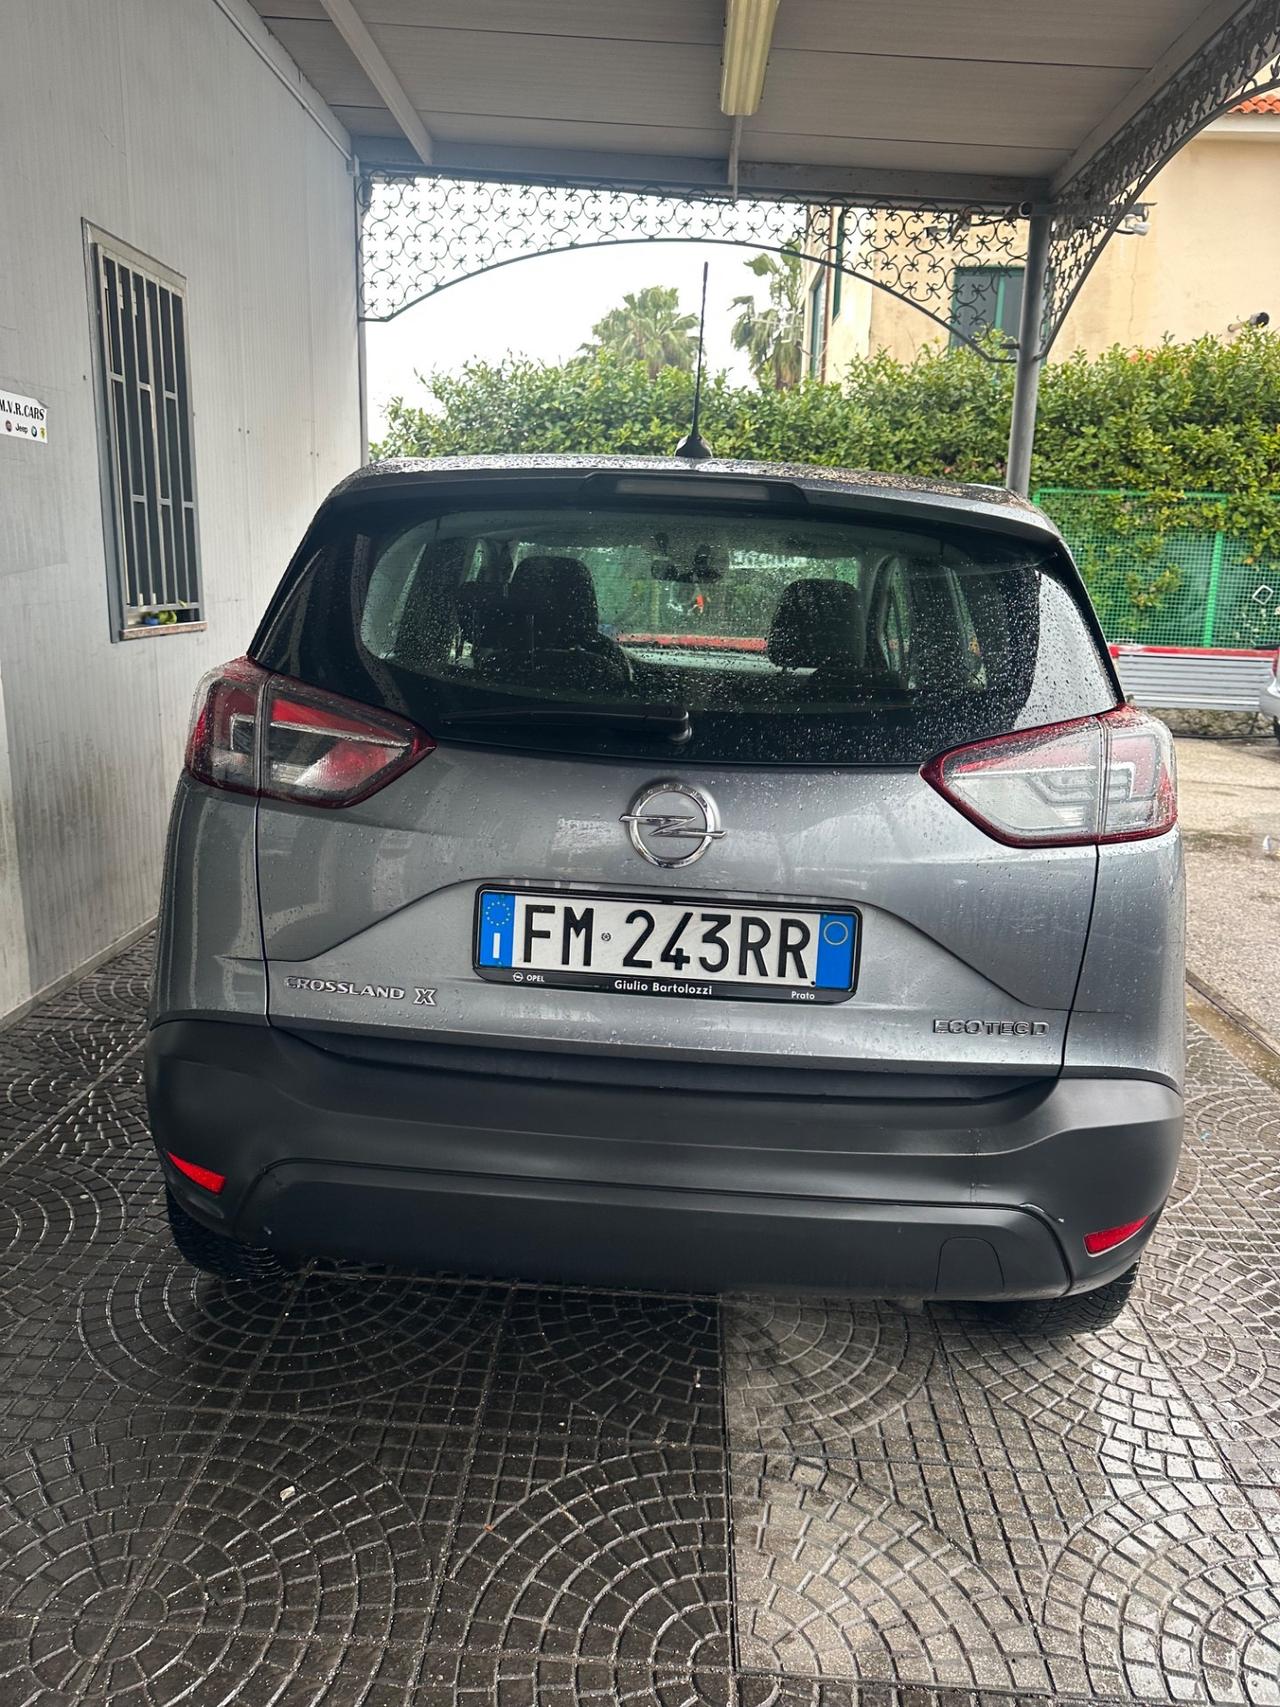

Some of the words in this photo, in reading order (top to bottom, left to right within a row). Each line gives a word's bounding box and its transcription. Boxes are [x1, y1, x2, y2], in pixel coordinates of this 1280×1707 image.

[622, 909, 811, 979] 243RR
[526, 974, 545, 983] OPEL
[284, 976, 405, 999] CROSSLAND
[413, 986, 438, 1006] X
[614, 980, 649, 992] Giulio
[652, 982, 713, 996] Bartolozzi
[791, 990, 815, 1000] Prato
